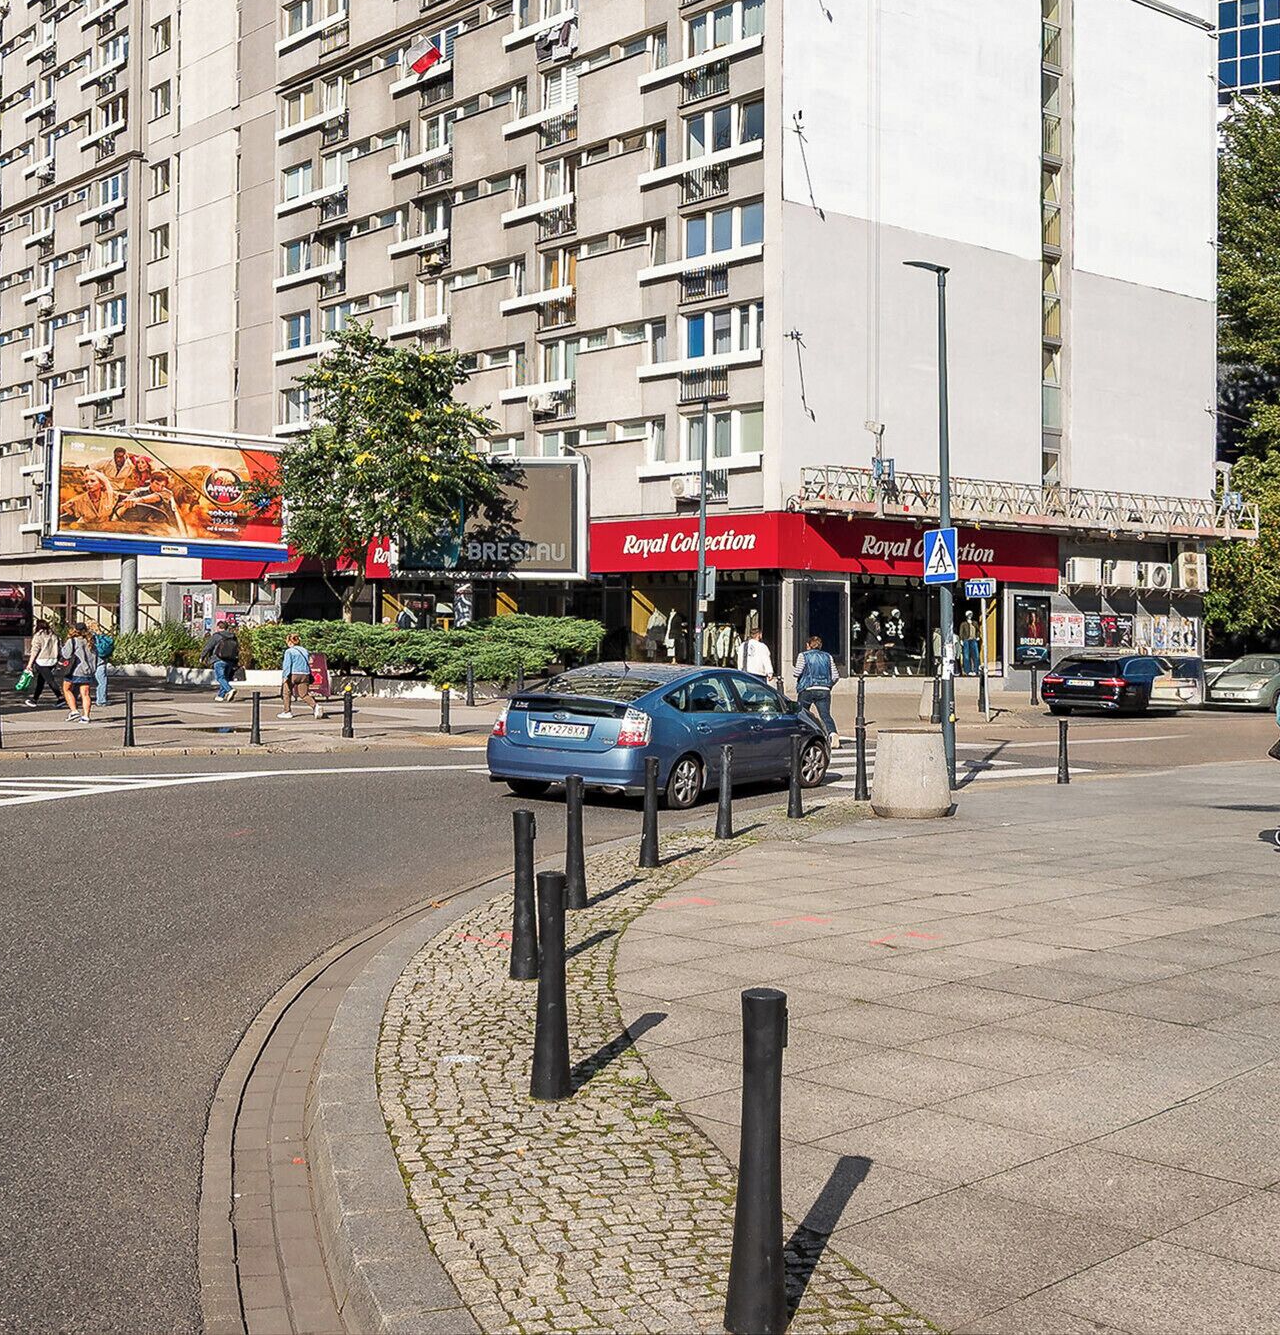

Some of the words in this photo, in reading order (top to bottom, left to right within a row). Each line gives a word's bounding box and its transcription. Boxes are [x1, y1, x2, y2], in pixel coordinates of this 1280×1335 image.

[467, 541, 566, 562] BRESLAU
[622, 532, 670, 559] Royal
[861, 534, 911, 561] Royal
[913, 541, 995, 563] Cction
[966, 583, 990, 597] TAXI
